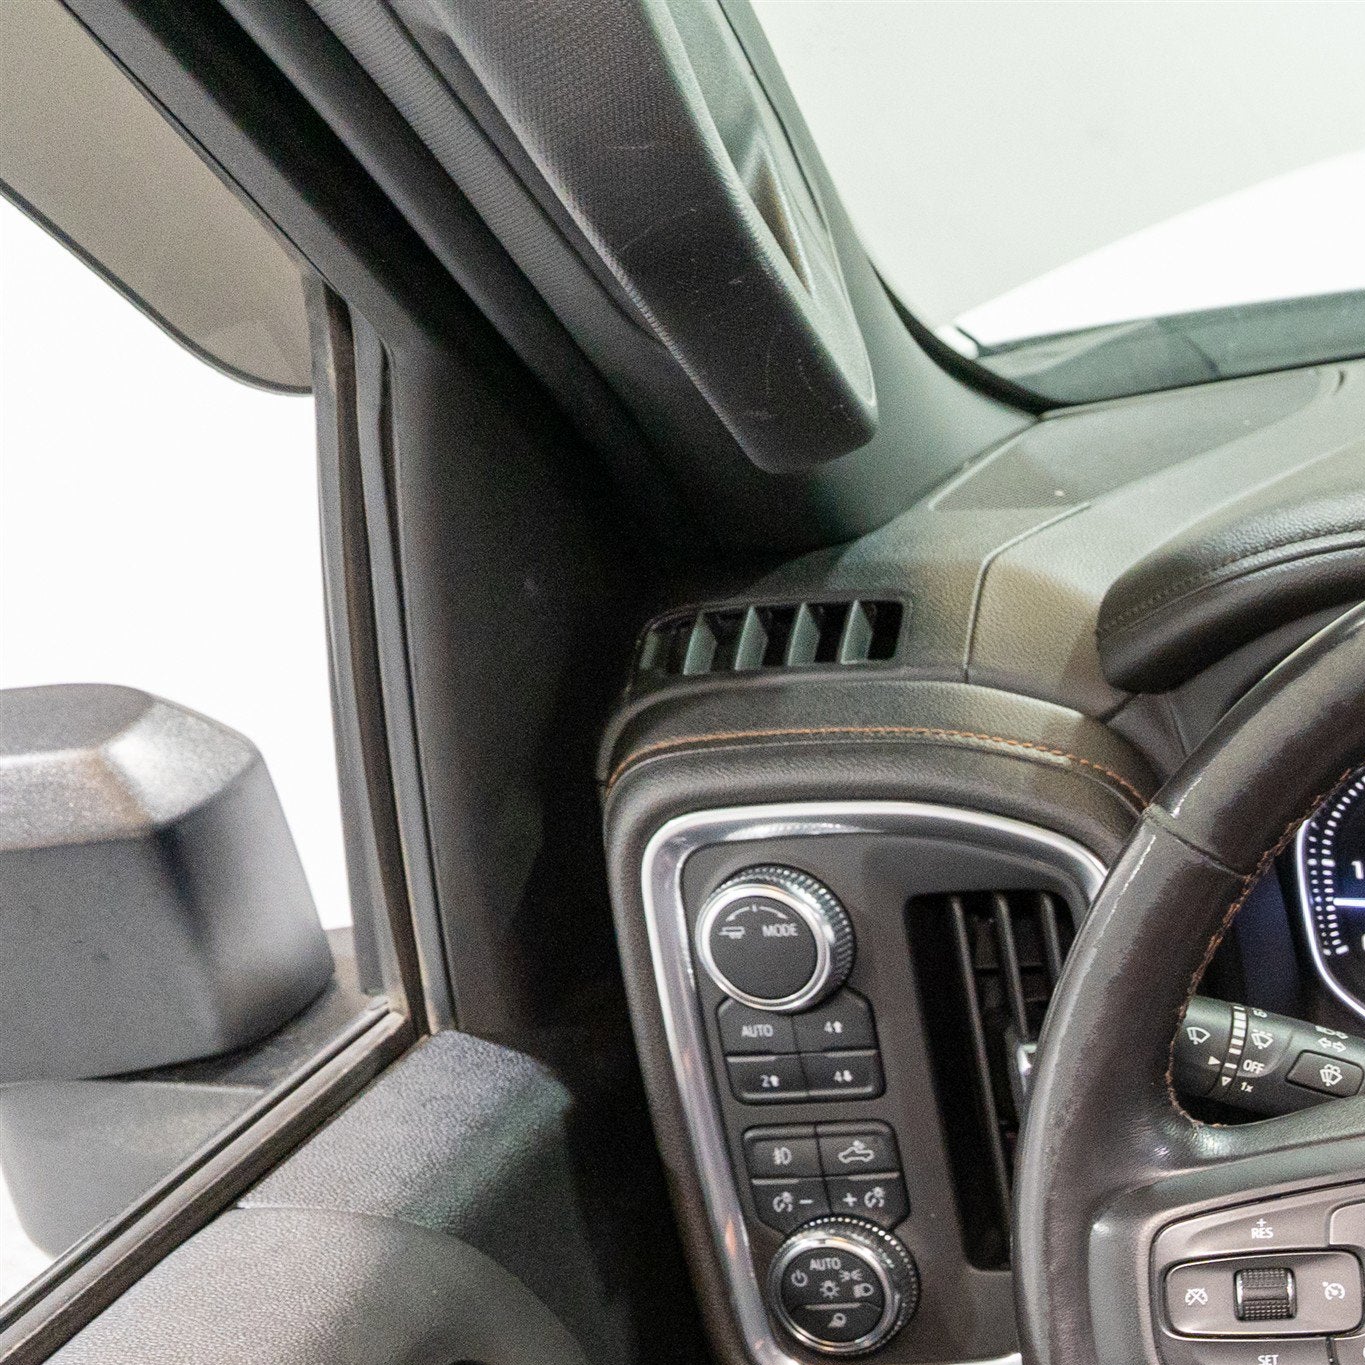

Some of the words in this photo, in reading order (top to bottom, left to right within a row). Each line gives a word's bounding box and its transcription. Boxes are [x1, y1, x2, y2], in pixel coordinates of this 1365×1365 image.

[1351, 861, 1364, 880] 1
[762, 924, 798, 937] MODE
[741, 1023, 773, 1037] AUTO
[1243, 1060, 1265, 1073] OFF
[1240, 1081, 1254, 1092] 1x
[1251, 1227, 1274, 1239] RES
[810, 1258, 841, 1271] AUTO
[1258, 1354, 1279, 1365] SET
